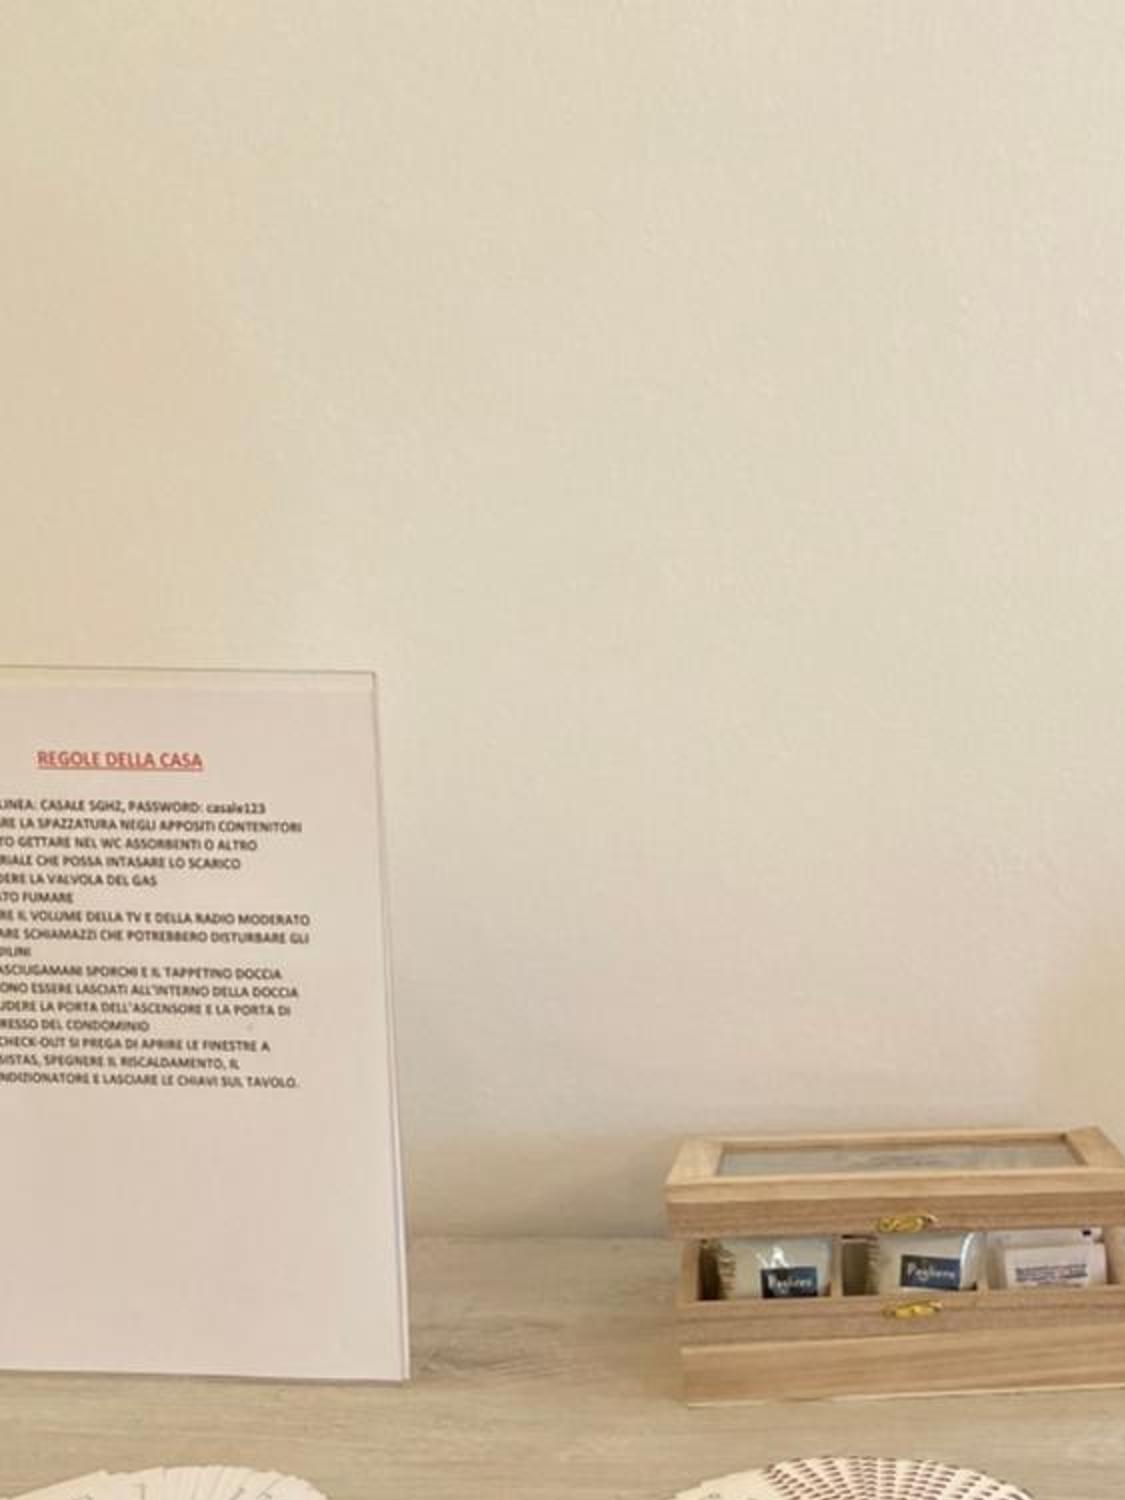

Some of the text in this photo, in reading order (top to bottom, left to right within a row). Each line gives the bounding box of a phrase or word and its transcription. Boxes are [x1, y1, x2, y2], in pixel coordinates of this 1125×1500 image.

[37, 750, 203, 770] REGOLE DELLA CASA
[40, 799, 84, 811] CASALE
[128, 800, 204, 813] PASSWORD:
[20, 818, 35, 829] LA
[37, 818, 118, 830] SPAZZATURA
[120, 819, 157, 831] NEGLI
[160, 819, 216, 832] APPOSITI
[218, 820, 303, 833] CONTENITORI
[18, 836, 71, 848] GETTARE
[74, 838, 99, 848] NEL
[100, 838, 121, 849] WC
[125, 838, 202, 850] ASSORBENTI
[204, 839, 214, 851] O
[217, 839, 258, 851] ALTRO
[36, 855, 60, 866] CHE
[62, 855, 102, 867] POSSA
[106, 856, 165, 868] INTASARE
[168, 857, 186, 869] LO
[188, 857, 241, 870] SCARICO
[30, 873, 46, 885] LA
[47, 874, 103, 886] VALVOLA
[106, 874, 129, 886] DEL
[132, 874, 158, 887] GAS
[22, 891, 73, 903] FUMARE
[18, 910, 29, 922] IL
[30, 910, 82, 922] VOLUME
[86, 911, 124, 923] DELLA
[126, 911, 141, 924] TV
[145, 912, 152, 924] E
[155, 912, 192, 925] DELLA
[195, 912, 235, 925] RADIO
[238, 913, 310, 926] MODERATO
[23, 928, 98, 941] SCHIAMAZZI
[100, 929, 123, 941] CHE
[127, 929, 208, 943] POTREBBERO
[210, 931, 286, 944] DISTURBARE
[289, 932, 310, 945] GLI
[86, 965, 139, 977] SPORCHI
[141, 966, 148, 978] E
[151, 966, 162, 978] IL
[164, 966, 233, 980] TAPPETINO
[235, 968, 283, 981] DOCCIA
[31, 982, 72, 994] ESSERE
[76, 983, 130, 995] LASCIATI
[132, 984, 210, 997] ALL'INTERNO
[212, 985, 250, 998] DELLA
[252, 986, 299, 999] DOCCIA
[40, 1000, 55, 1012] LA
[57, 1001, 98, 1013] PORTA
[101, 1002, 202, 1015] DELL'ASCENSORE
[205, 1003, 212, 1015] E
[215, 1003, 231, 1016] LA
[233, 1004, 275, 1016] PORTA
[278, 1005, 291, 1017] DI
[41, 1019, 63, 1031] DEL
[66, 1020, 150, 1032] CONDOMINIO
[69, 1036, 80, 1049] SI
[82, 1037, 122, 1049] PREGA
[125, 1037, 139, 1050] DI
[141, 1038, 183, 1051] APRIRE
[186, 1038, 199, 1051] LE
[202, 1039, 257, 1052] FINESTRE
[260, 1040, 271, 1053] A
[43, 1054, 104, 1066] SPEGNERE
[107, 1055, 118, 1067] IL
[120, 1055, 227, 1070] RISCALDAMENTO,
[229, 1058, 240, 1071] IL
[93, 1073, 100, 1085] E
[103, 1073, 158, 1086] LASCIARE
[161, 1074, 174, 1086] LE
[177, 1074, 219, 1088] CHIAVI
[221, 1075, 244, 1088] SUL
[246, 1076, 299, 1089] TAVOLO.
